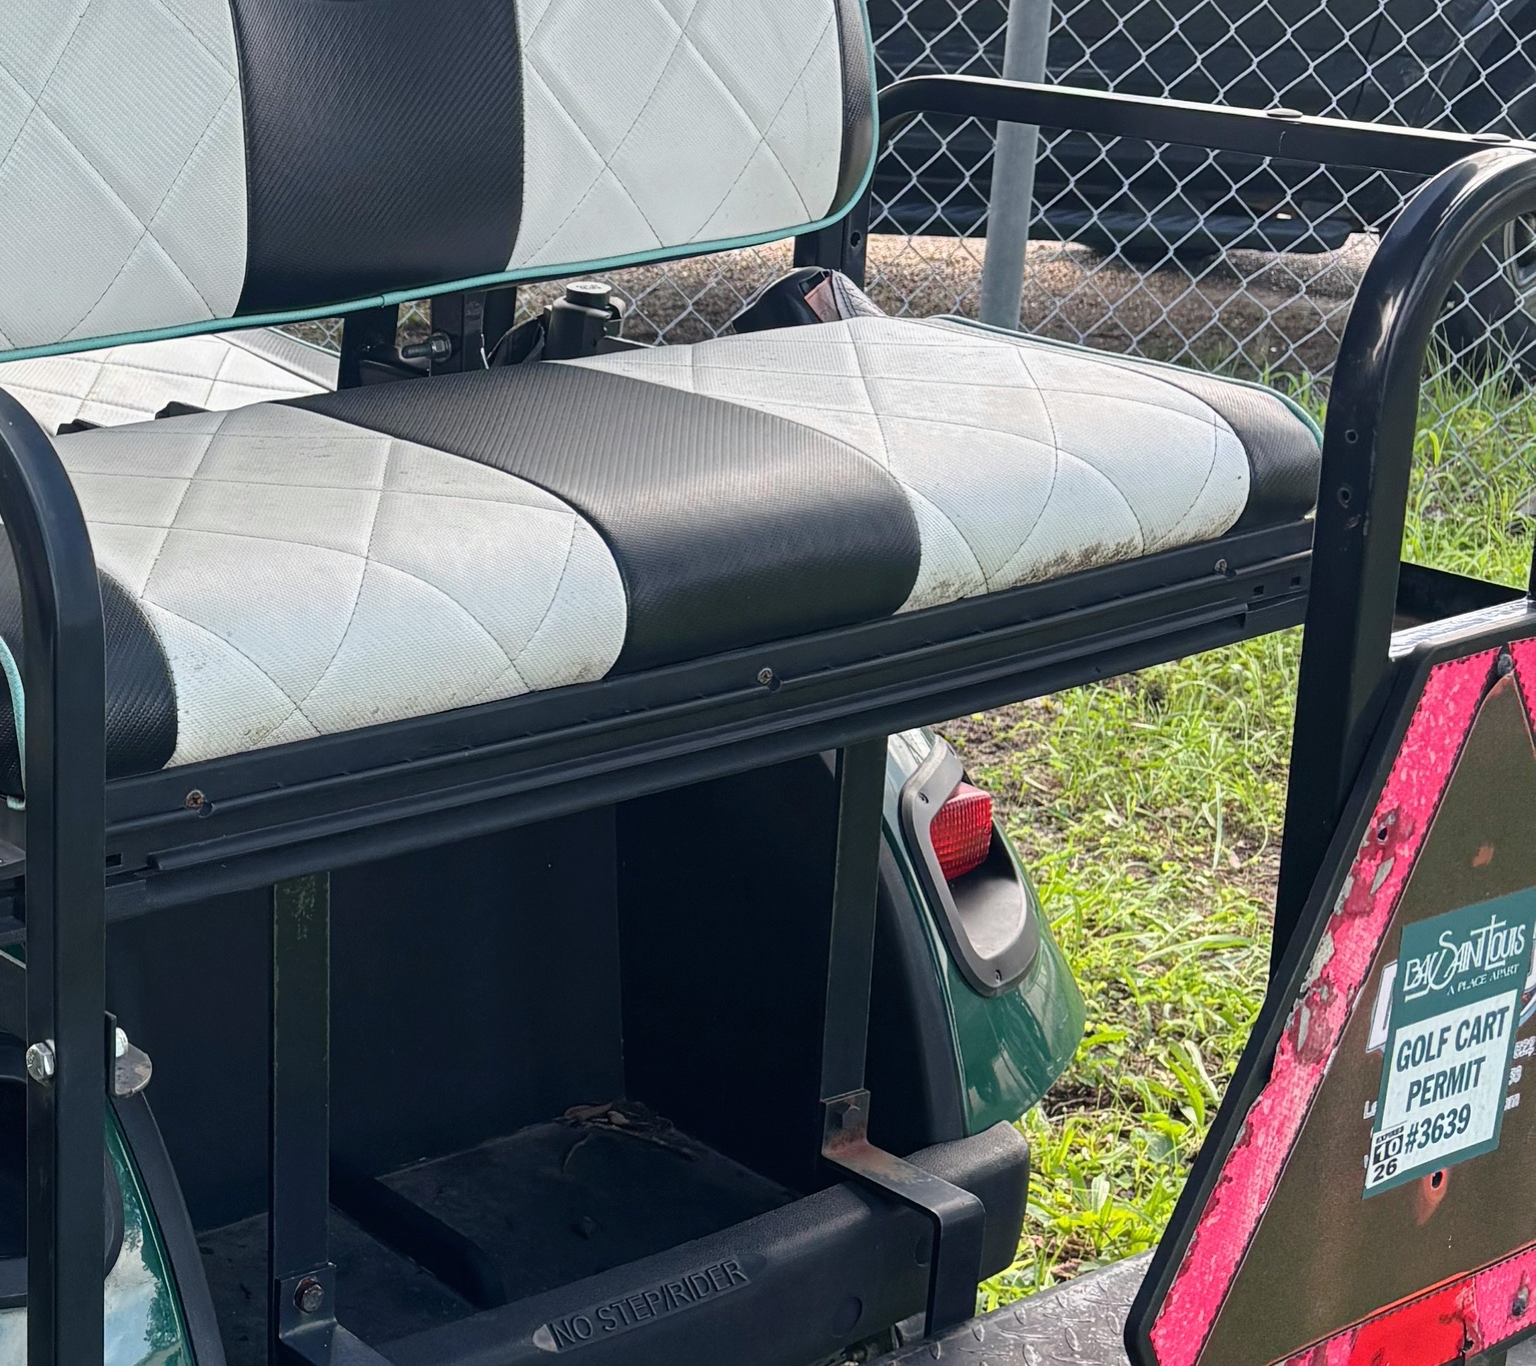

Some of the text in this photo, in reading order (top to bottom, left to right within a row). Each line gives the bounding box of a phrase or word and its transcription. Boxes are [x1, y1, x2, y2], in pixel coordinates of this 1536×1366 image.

[1457, 974, 1488, 992] PLACE
[1489, 963, 1520, 983] APART
[1396, 1025, 1453, 1074] GOLF
[1455, 1005, 1511, 1052] CART
[1405, 1056, 1487, 1113] PERMIT
[1375, 1136, 1402, 1164] 10
[1404, 1102, 1472, 1155] #3639
[1372, 1157, 1398, 1184] 26
[549, 1259, 749, 1348] NO STEP/RIDER
